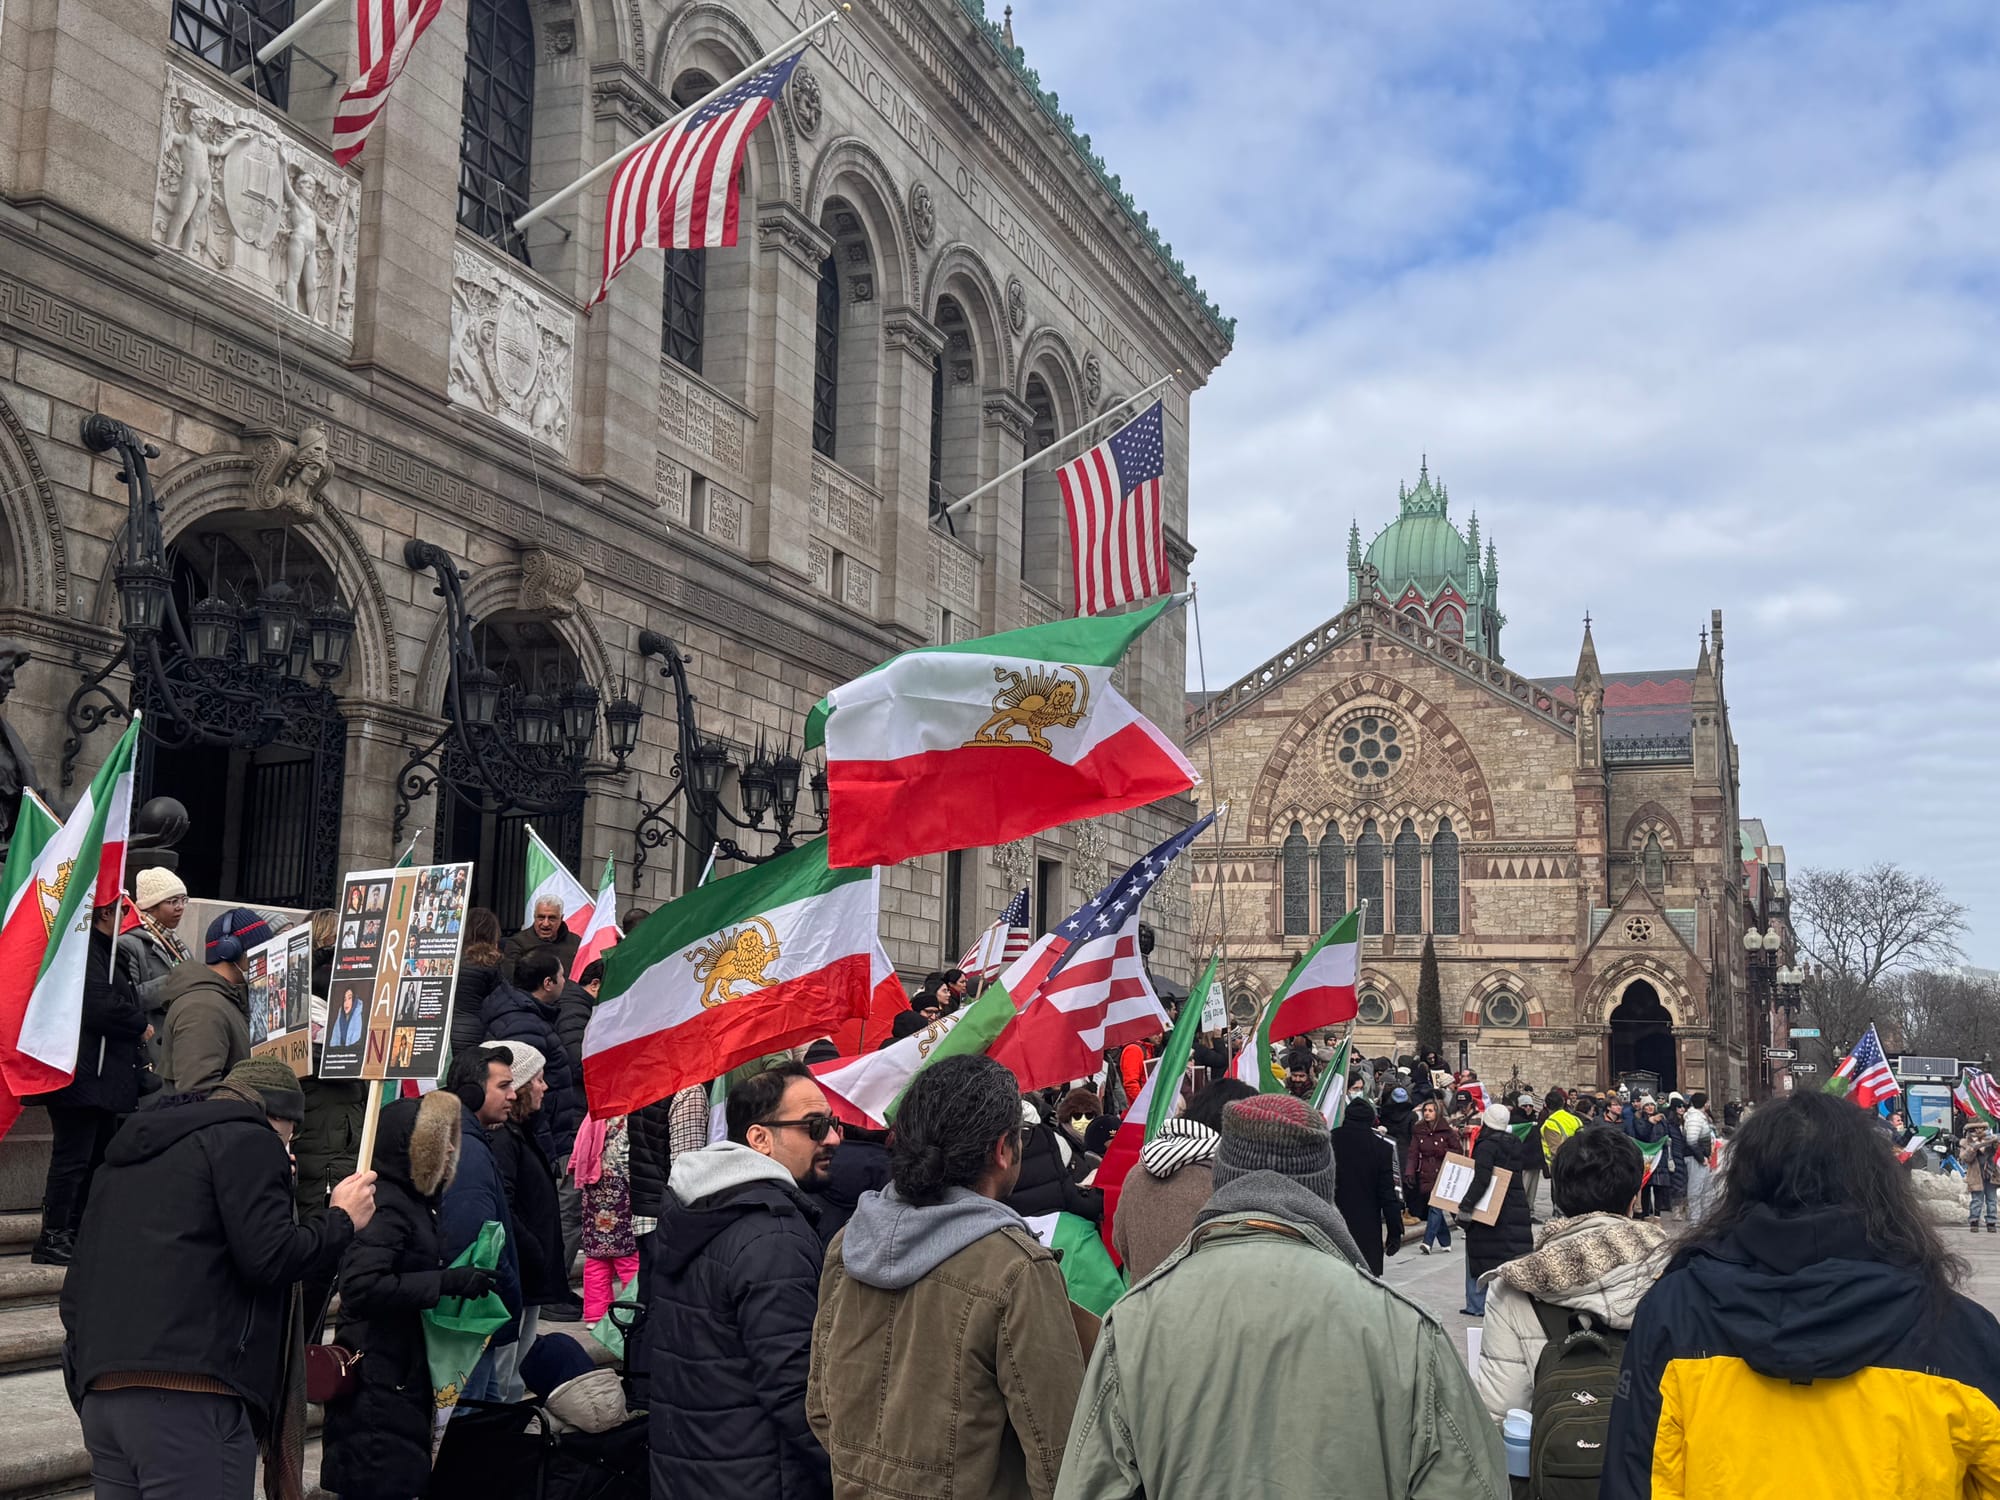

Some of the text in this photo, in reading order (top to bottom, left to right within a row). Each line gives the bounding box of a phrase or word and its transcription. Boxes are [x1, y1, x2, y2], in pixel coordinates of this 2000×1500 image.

[795, 2, 944, 169] ADVANCEMENT
[956, 167, 979, 204] OF
[988, 199, 1061, 295] LEARNING
[660, 369, 679, 387] OMER
[366, 885, 407, 1064] IRAN
[291, 1039, 308, 1061] IRAN
